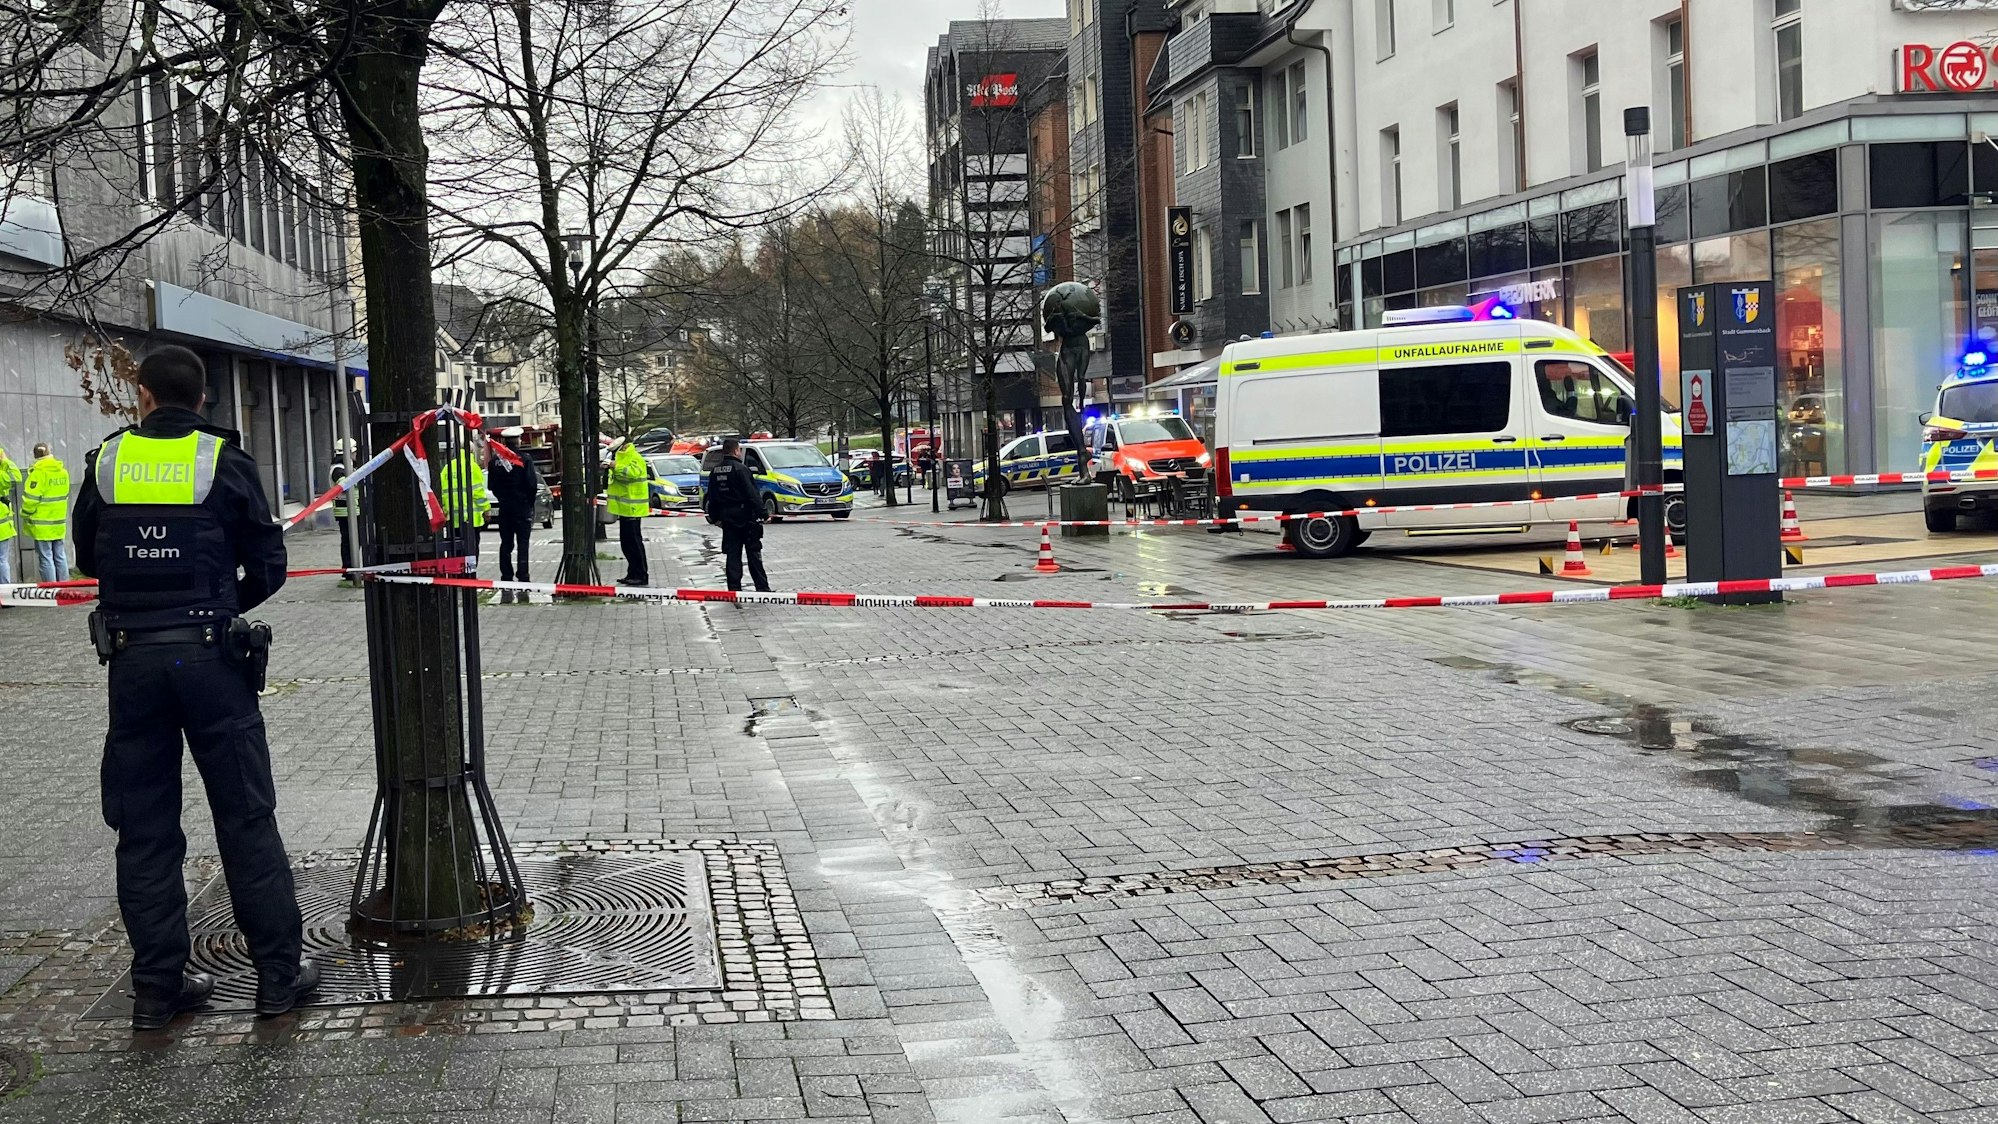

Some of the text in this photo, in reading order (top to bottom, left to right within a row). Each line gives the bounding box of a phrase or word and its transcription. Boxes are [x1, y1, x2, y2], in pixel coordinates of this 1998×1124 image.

[1903, 42, 1998, 91] RO
[990, 82, 1018, 100] Post
[1178, 282, 1186, 291] &
[1976, 293, 1998, 305] SONN
[1394, 342, 1504, 359] UNFALLAUFNAHME
[1942, 444, 1980, 454] POLIZEI
[1394, 452, 1477, 473] POLIZEI
[120, 463, 190, 483] POLIZEI
[138, 526, 167, 540] VU
[124, 545, 180, 559] Team
